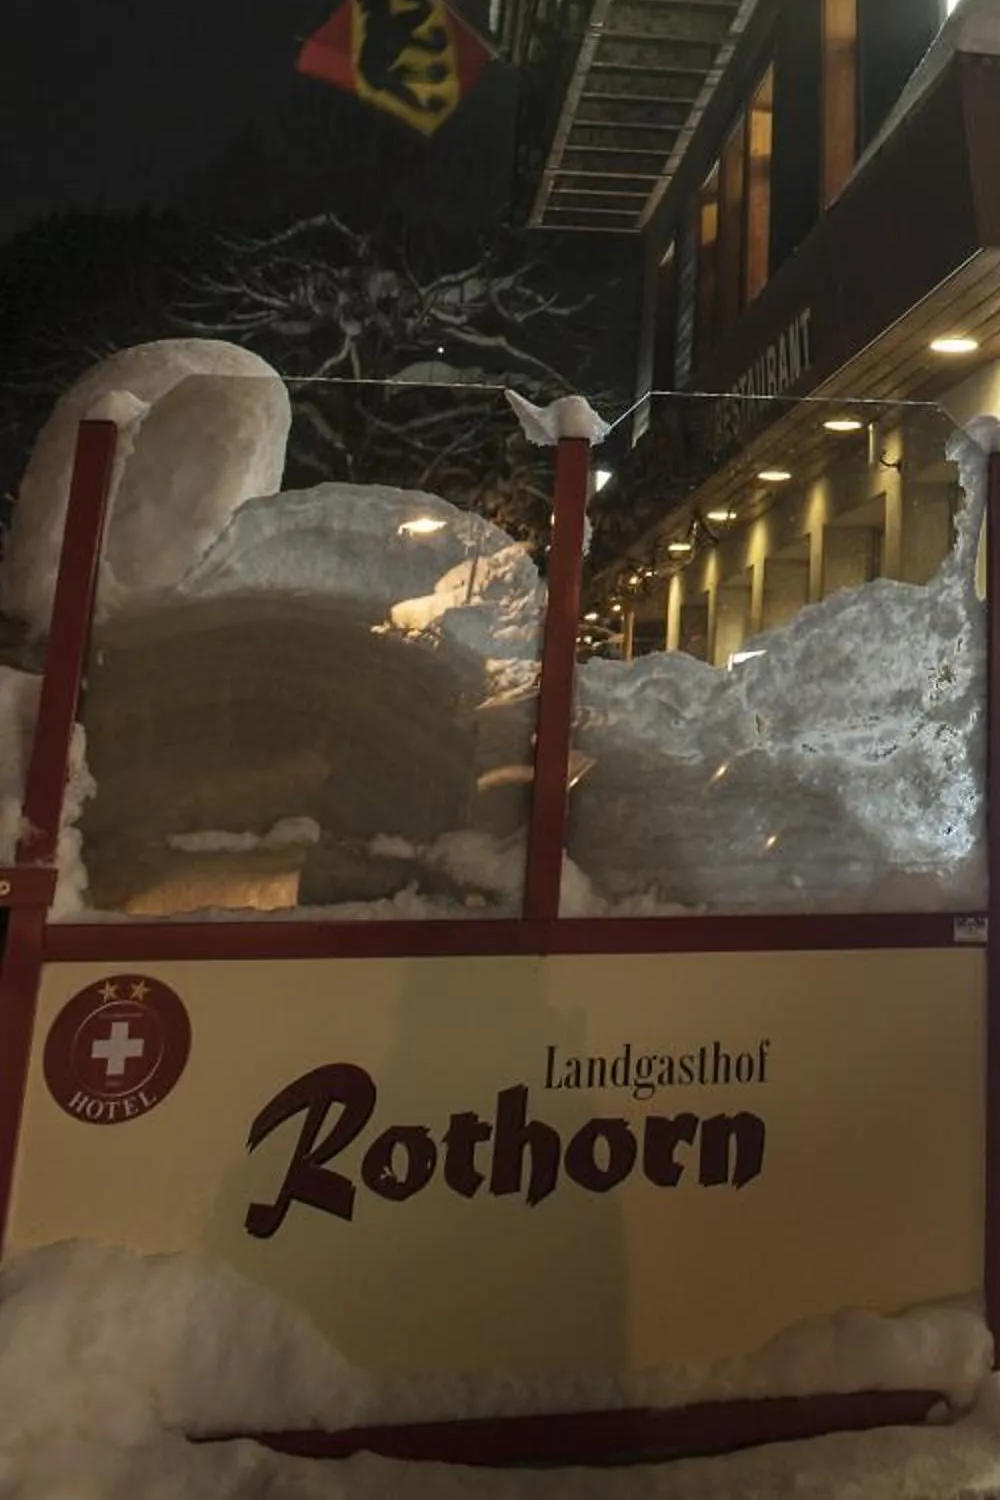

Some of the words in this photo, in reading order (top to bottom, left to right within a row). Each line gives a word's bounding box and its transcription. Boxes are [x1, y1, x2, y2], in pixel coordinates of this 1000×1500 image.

[544, 1040, 771, 1100] Landgasthof
[68, 1090, 158, 1121] HOTEL
[244, 1062, 767, 1239] Rothorn
